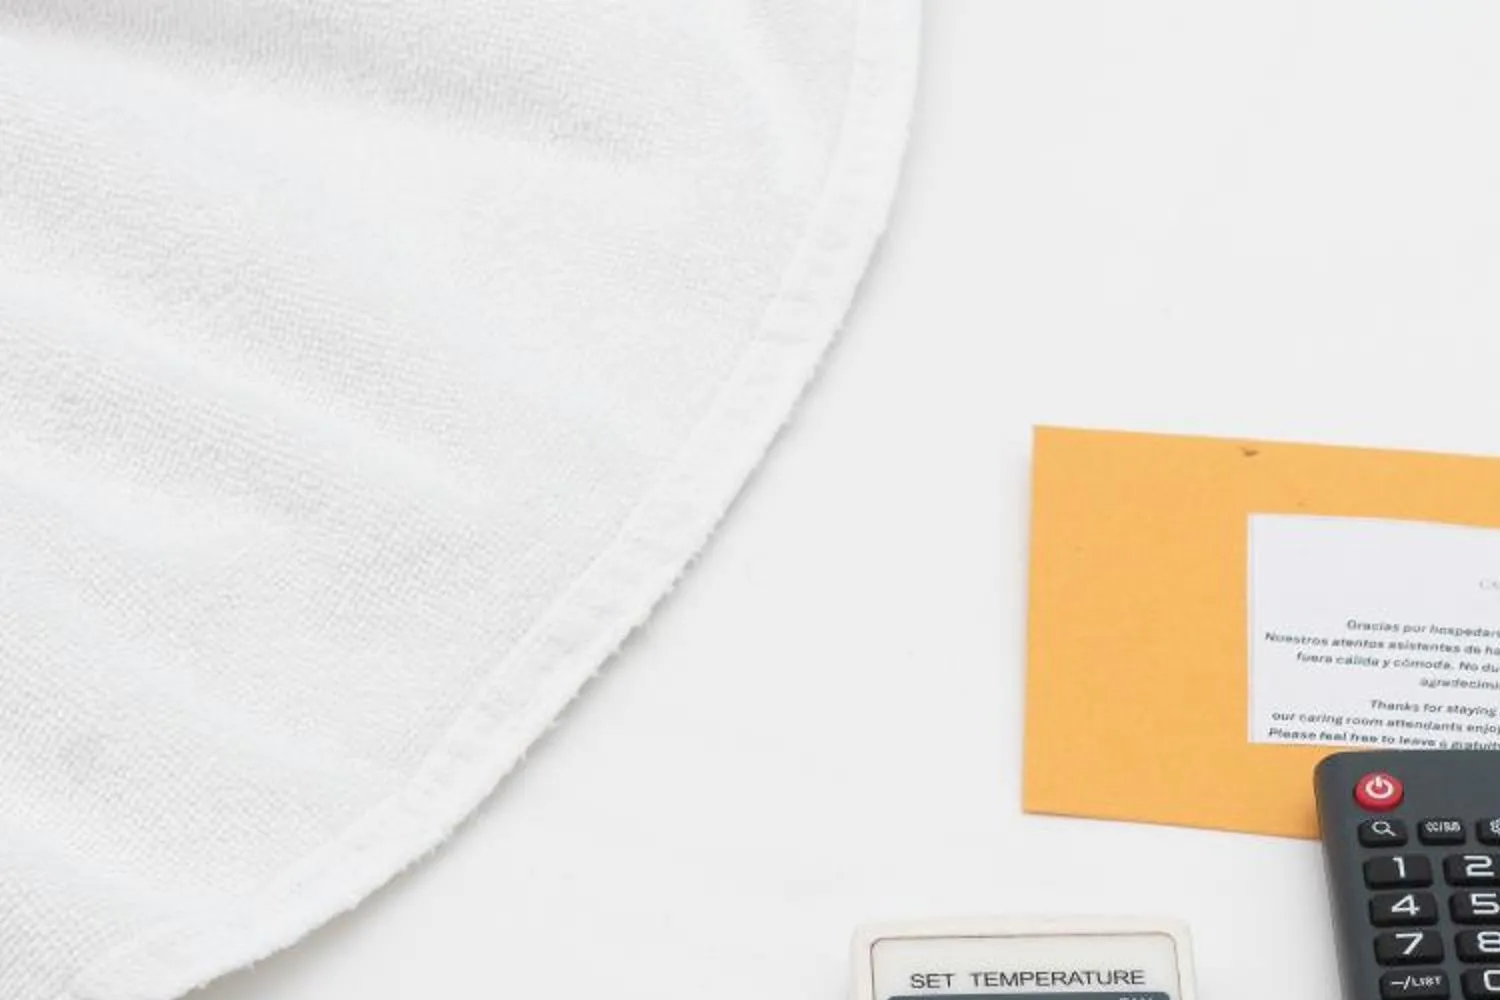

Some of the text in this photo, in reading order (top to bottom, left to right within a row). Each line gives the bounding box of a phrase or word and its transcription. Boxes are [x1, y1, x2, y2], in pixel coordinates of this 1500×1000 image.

[1347, 619, 1400, 633] Gracias
[1403, 624, 1425, 634] por
[1265, 632, 1329, 646] Nuestros
[1331, 637, 1384, 649] atentos
[1388, 639, 1460, 653] asistentes
[1463, 644, 1482, 654] de
[1297, 651, 1333, 664] fuera
[1336, 653, 1380, 667] cálida
[1381, 659, 1391, 669] y
[1460, 661, 1479, 672] No
[1371, 699, 1419, 713] Thanks
[1424, 702, 1442, 713] for
[1447, 704, 1497, 719] staying
[1272, 712, 1295, 722] our
[1299, 712, 1344, 727] caring
[1346, 717, 1384, 727] room
[1386, 719, 1463, 732] attendants
[1268, 727, 1317, 740] Please
[1319, 730, 1347, 741] feel
[1350, 732, 1379, 743] free
[1381, 734, 1396, 744] to
[1399, 735, 1437, 747] leave
[1392, 856, 1407, 879] 1
[1463, 854, 1495, 878] 2
[1390, 894, 1421, 917] 4
[1470, 893, 1500, 915] 5
[1395, 932, 1424, 956] 7
[910, 969, 1145, 989] SET TEMPERATURE
